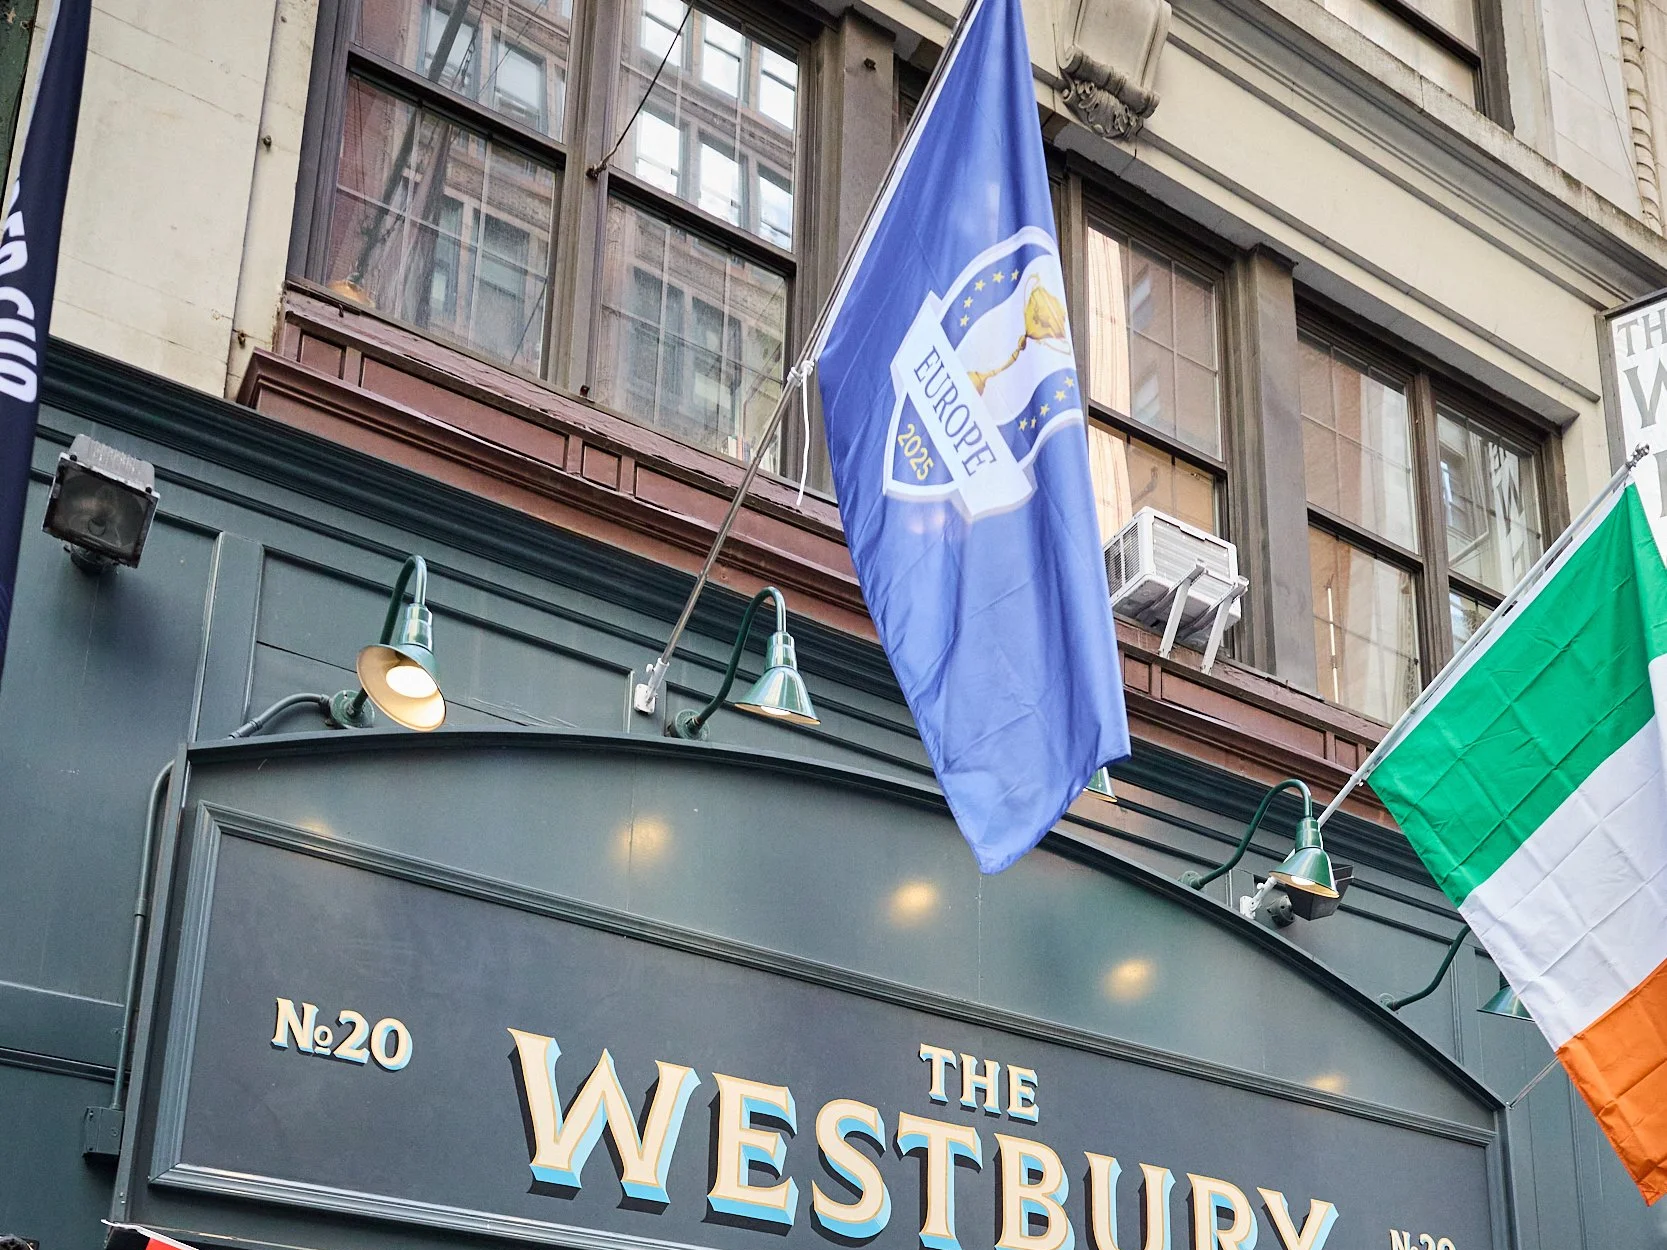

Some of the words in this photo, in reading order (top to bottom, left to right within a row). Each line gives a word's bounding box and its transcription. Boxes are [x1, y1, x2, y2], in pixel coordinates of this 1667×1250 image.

[914, 345, 997, 477] EUROPE
[898, 423, 934, 481] 2025
[919, 1042, 1039, 1123] THE
